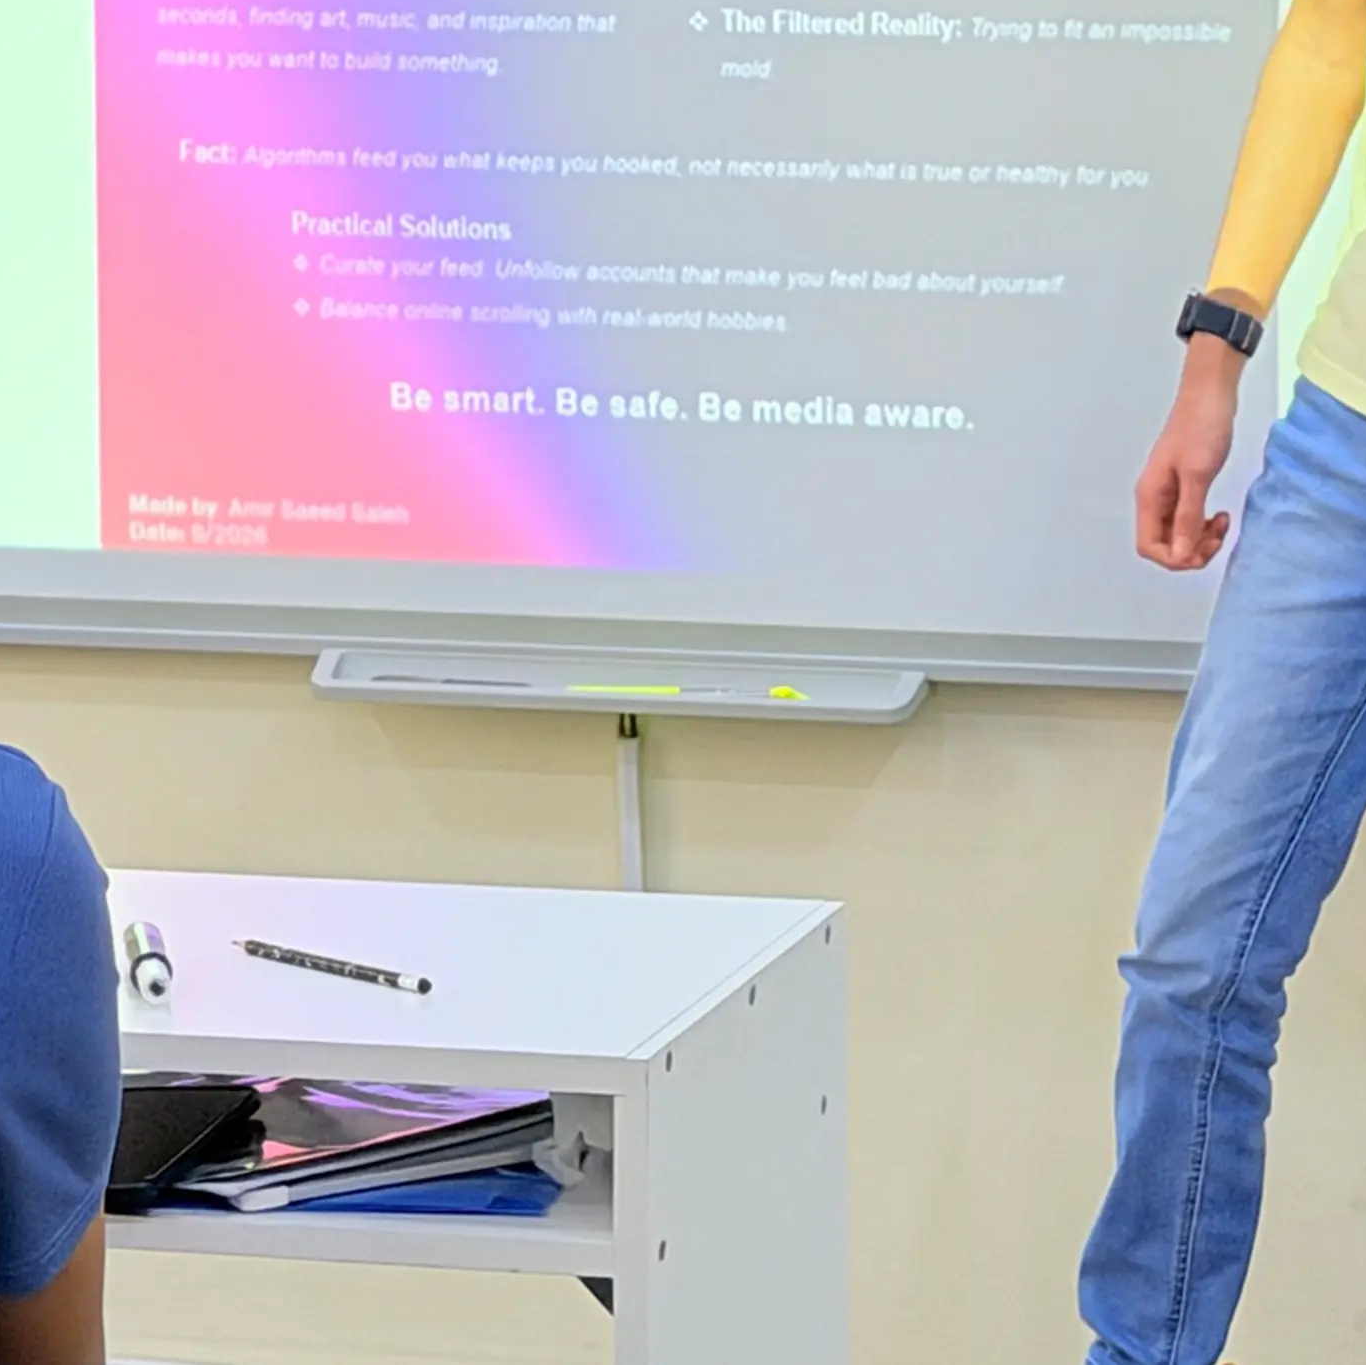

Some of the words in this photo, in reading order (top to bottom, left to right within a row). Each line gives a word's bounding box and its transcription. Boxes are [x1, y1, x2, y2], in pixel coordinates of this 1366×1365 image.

[721, 8, 766, 33] The
[773, 9, 864, 35] Filtered
[871, 11, 962, 43] Reality:
[973, 17, 1032, 43] Trying
[1038, 20, 1058, 38] to
[1064, 19, 1083, 39] fit
[1088, 23, 1115, 39] an
[1121, 22, 1232, 44] impossible
[291, 210, 393, 236] Practical
[399, 214, 512, 240] Solutions
[390, 382, 432, 411] Be
[444, 387, 544, 414] smart.
[556, 388, 598, 417] Be
[610, 390, 687, 420] safe.
[699, 392, 741, 422] Be
[753, 396, 853, 426] media
[864, 404, 974, 430] aware.
